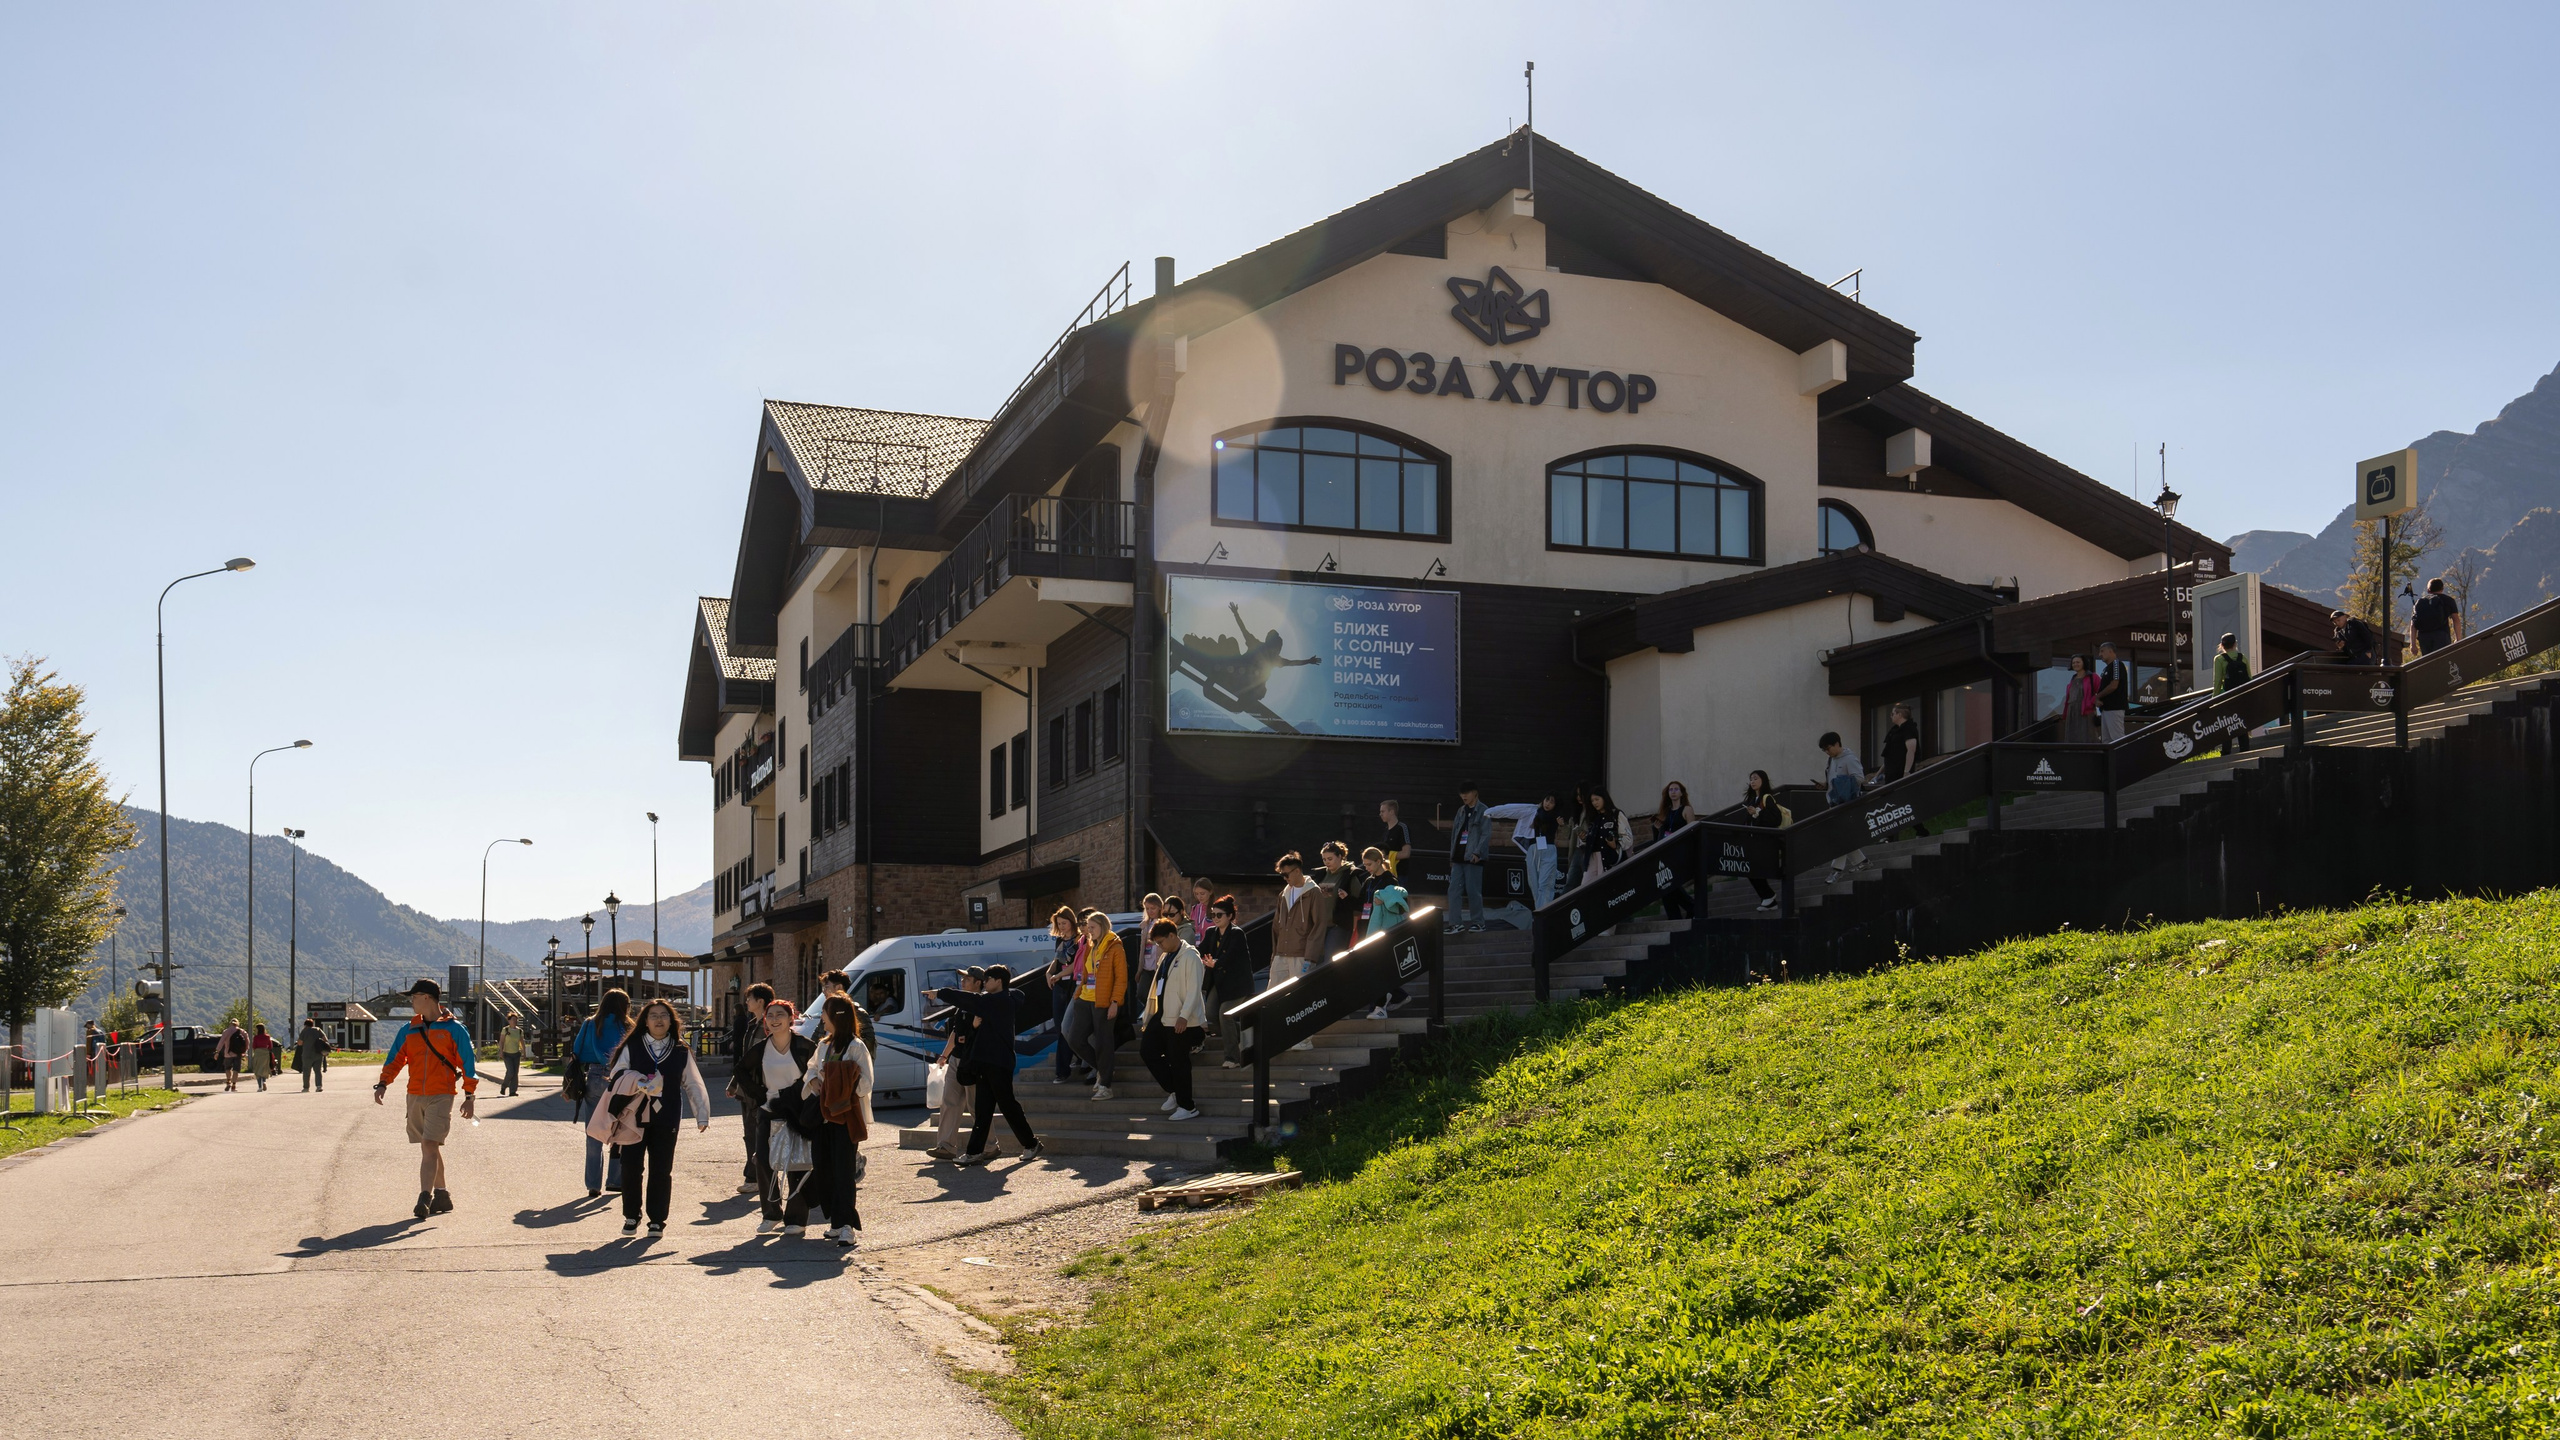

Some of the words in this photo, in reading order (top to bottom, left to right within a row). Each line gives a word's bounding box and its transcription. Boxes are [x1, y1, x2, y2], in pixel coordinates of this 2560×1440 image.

[1335, 343, 1475, 399] РОЗА
[1488, 360, 1657, 414] ХУТОР
[1357, 600, 1385, 611] РОЗА
[1387, 602, 1422, 613] ХУТОР
[1334, 621, 1389, 637] БЛИЖЕ
[2131, 631, 2167, 643] ПРОКАТ
[1334, 638, 1343, 650] К
[1349, 639, 1415, 656] СОЛНЦУ
[2500, 630, 2526, 652] FOOD
[2505, 643, 2529, 662] STREET
[1334, 655, 1382, 669] КРУЧЕ
[1334, 671, 1400, 687] ВИРАЖИ
[1334, 691, 1379, 701] Родельбан
[2139, 695, 2159, 703] ЛИФТ
[2302, 688, 2332, 696] есторан
[1334, 701, 1382, 710] аттракцион
[1394, 721, 1444, 729] rosakhutor.com
[2192, 713, 2241, 740] Sunshine
[2227, 718, 2247, 736] park
[1876, 804, 1913, 826] RIDERS
[1870, 821, 1899, 838] ДЕТСКИЙ
[1899, 814, 1916, 826] КЛУБ
[1607, 888, 1636, 909] Ресторан
[914, 939, 984, 949] huskykhutor.ru
[1032, 934, 1049, 943] 962
[602, 959, 638, 967] Родльбан
[1285, 998, 1328, 1026] Родельбан
